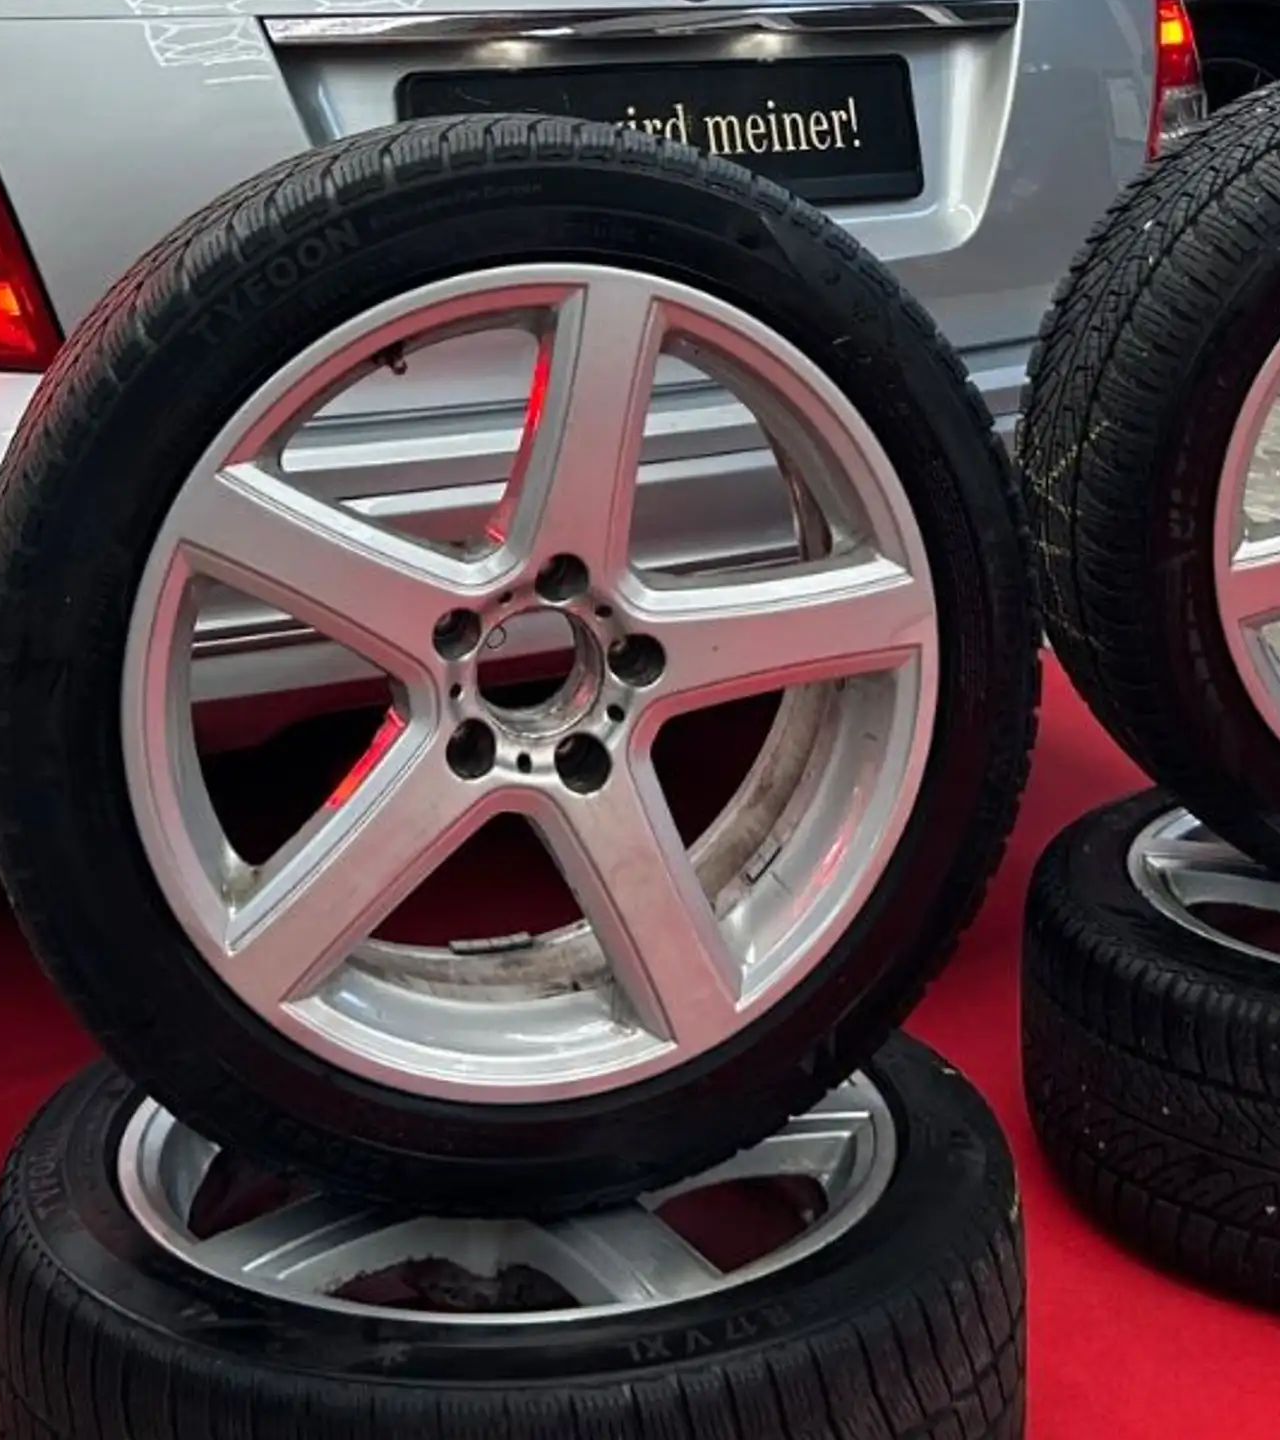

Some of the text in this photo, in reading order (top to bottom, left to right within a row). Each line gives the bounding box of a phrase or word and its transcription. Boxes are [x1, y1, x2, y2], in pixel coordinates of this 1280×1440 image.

[616, 95, 862, 157] ird meiner!
[189, 215, 362, 347] TYFOON
